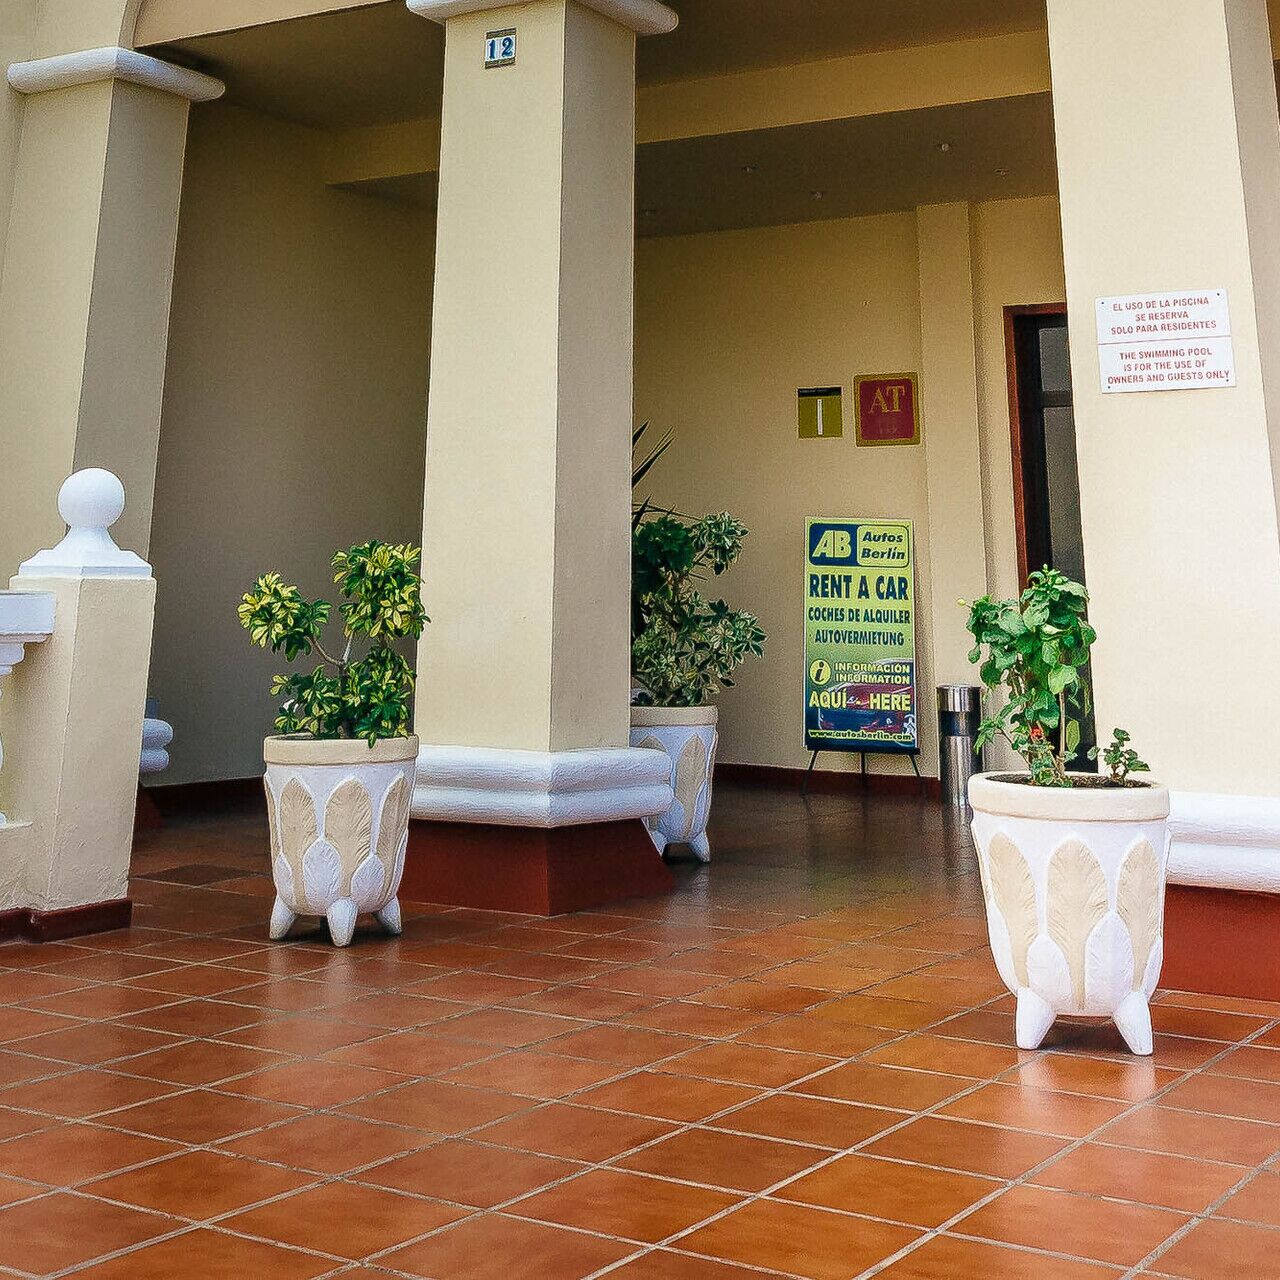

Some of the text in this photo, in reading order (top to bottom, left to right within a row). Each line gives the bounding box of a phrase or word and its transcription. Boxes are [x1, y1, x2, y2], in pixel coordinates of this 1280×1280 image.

[488, 37, 513, 60] 12
[1113, 297, 1209, 312] EL USO DE LA PISCINA
[1135, 311, 1189, 322] SE RESERVA
[1111, 320, 1217, 335] SOLO PARA RESIDENTES
[1120, 347, 1212, 360] THE SWIMMING POOL
[1124, 359, 1208, 372] IS FOR THE USE OF
[1108, 370, 1230, 385] OWNERS AND GUESTS ONLY
[868, 385, 905, 414] AT
[812, 530, 852, 558] AB
[862, 531, 903, 543] Autos
[809, 574, 909, 600] RENT A CAR
[808, 607, 910, 624] COCHES DE ALQUILER
[815, 629, 904, 646] AUTOVERMIETUNG
[835, 661, 910, 673] INFORMACIÓN
[835, 673, 910, 684] INFORMATION
[809, 688, 911, 711] AQUÍ HERE
[808, 730, 911, 740] www.autosberlin.com
